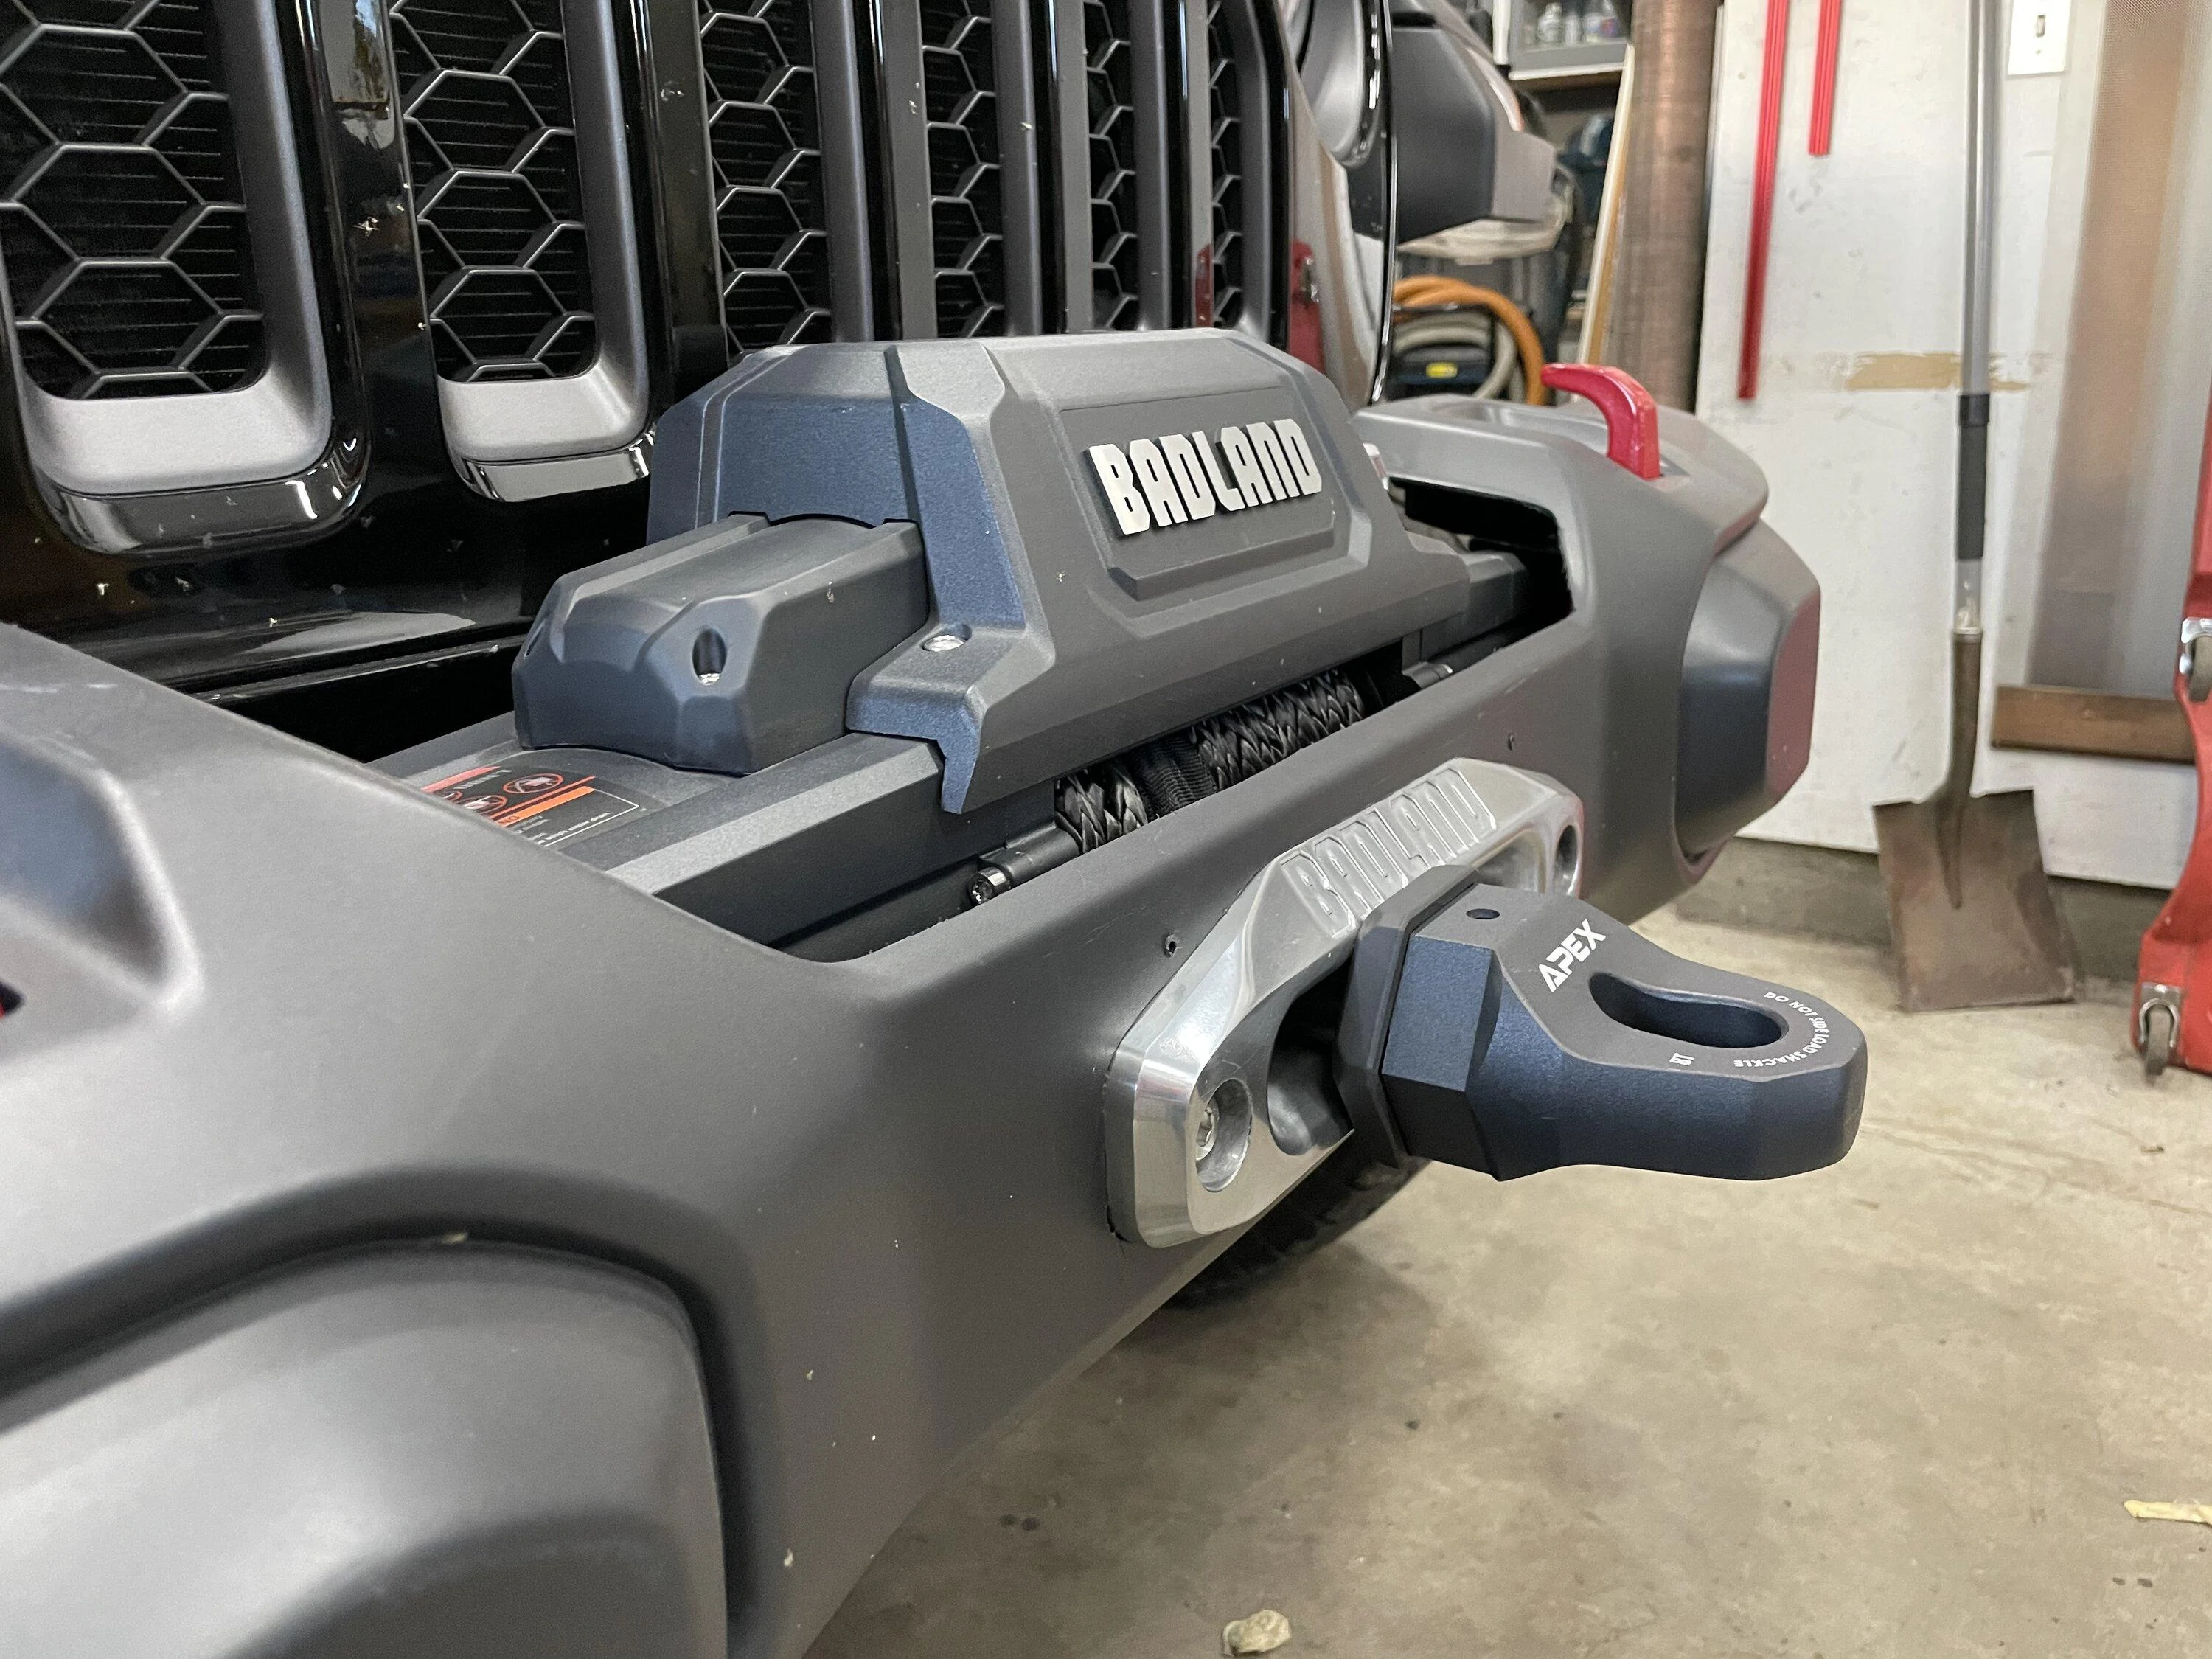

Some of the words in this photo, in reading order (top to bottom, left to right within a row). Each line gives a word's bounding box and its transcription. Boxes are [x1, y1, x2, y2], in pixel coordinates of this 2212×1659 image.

[1088, 418, 1323, 535] BADLAND
[1280, 768, 1497, 938] BADLAND
[1538, 919, 1607, 993] APEX
[1764, 992, 1790, 1002] DO
[1788, 1001, 1818, 1016] NOT
[1809, 1017, 1829, 1034] SIDE
[1802, 1033, 1829, 1054] LOAD
[1733, 1051, 1808, 1067] SHACKLE
